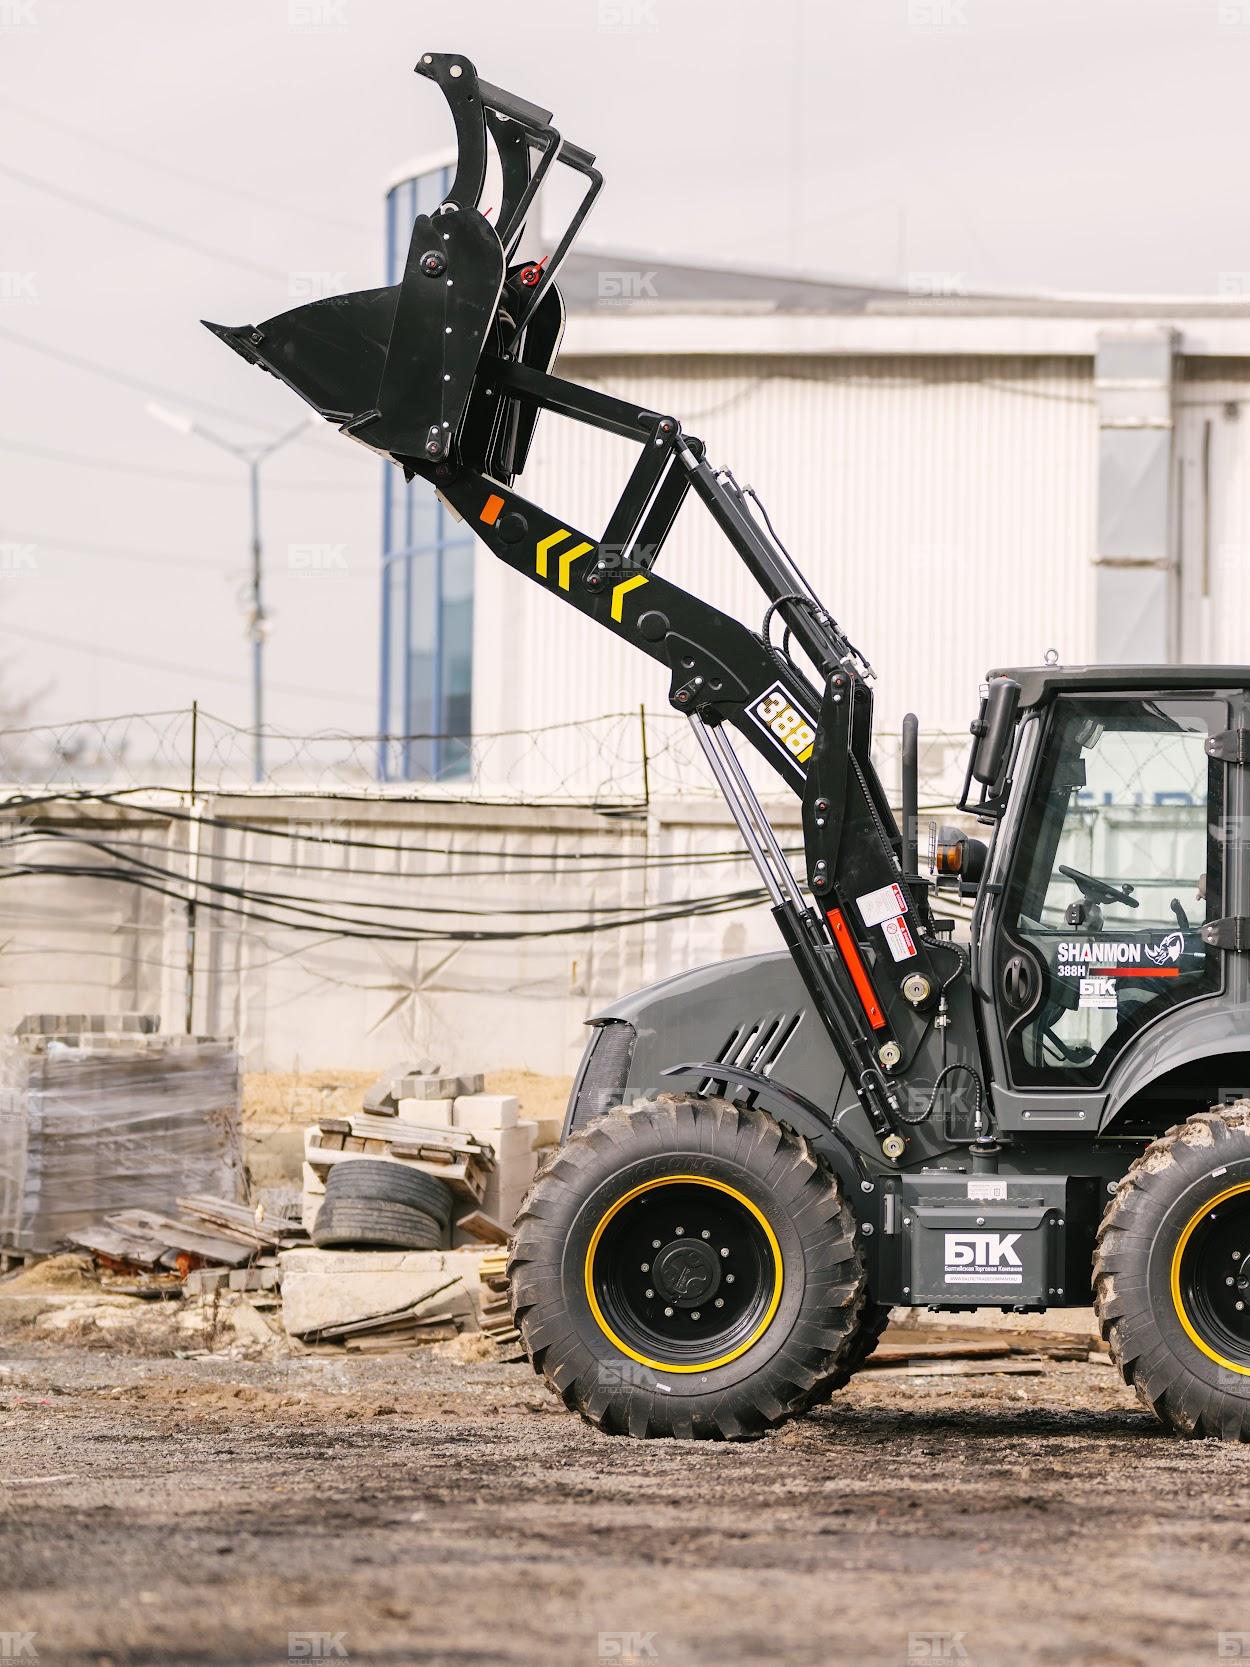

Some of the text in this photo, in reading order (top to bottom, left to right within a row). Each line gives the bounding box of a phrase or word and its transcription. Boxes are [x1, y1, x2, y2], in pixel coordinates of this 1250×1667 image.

[1057, 942, 1141, 962] SHANMON
[1057, 965, 1086, 977] 388H
[1079, 979, 1117, 995] БТК
[945, 1234, 1023, 1266] БТК
